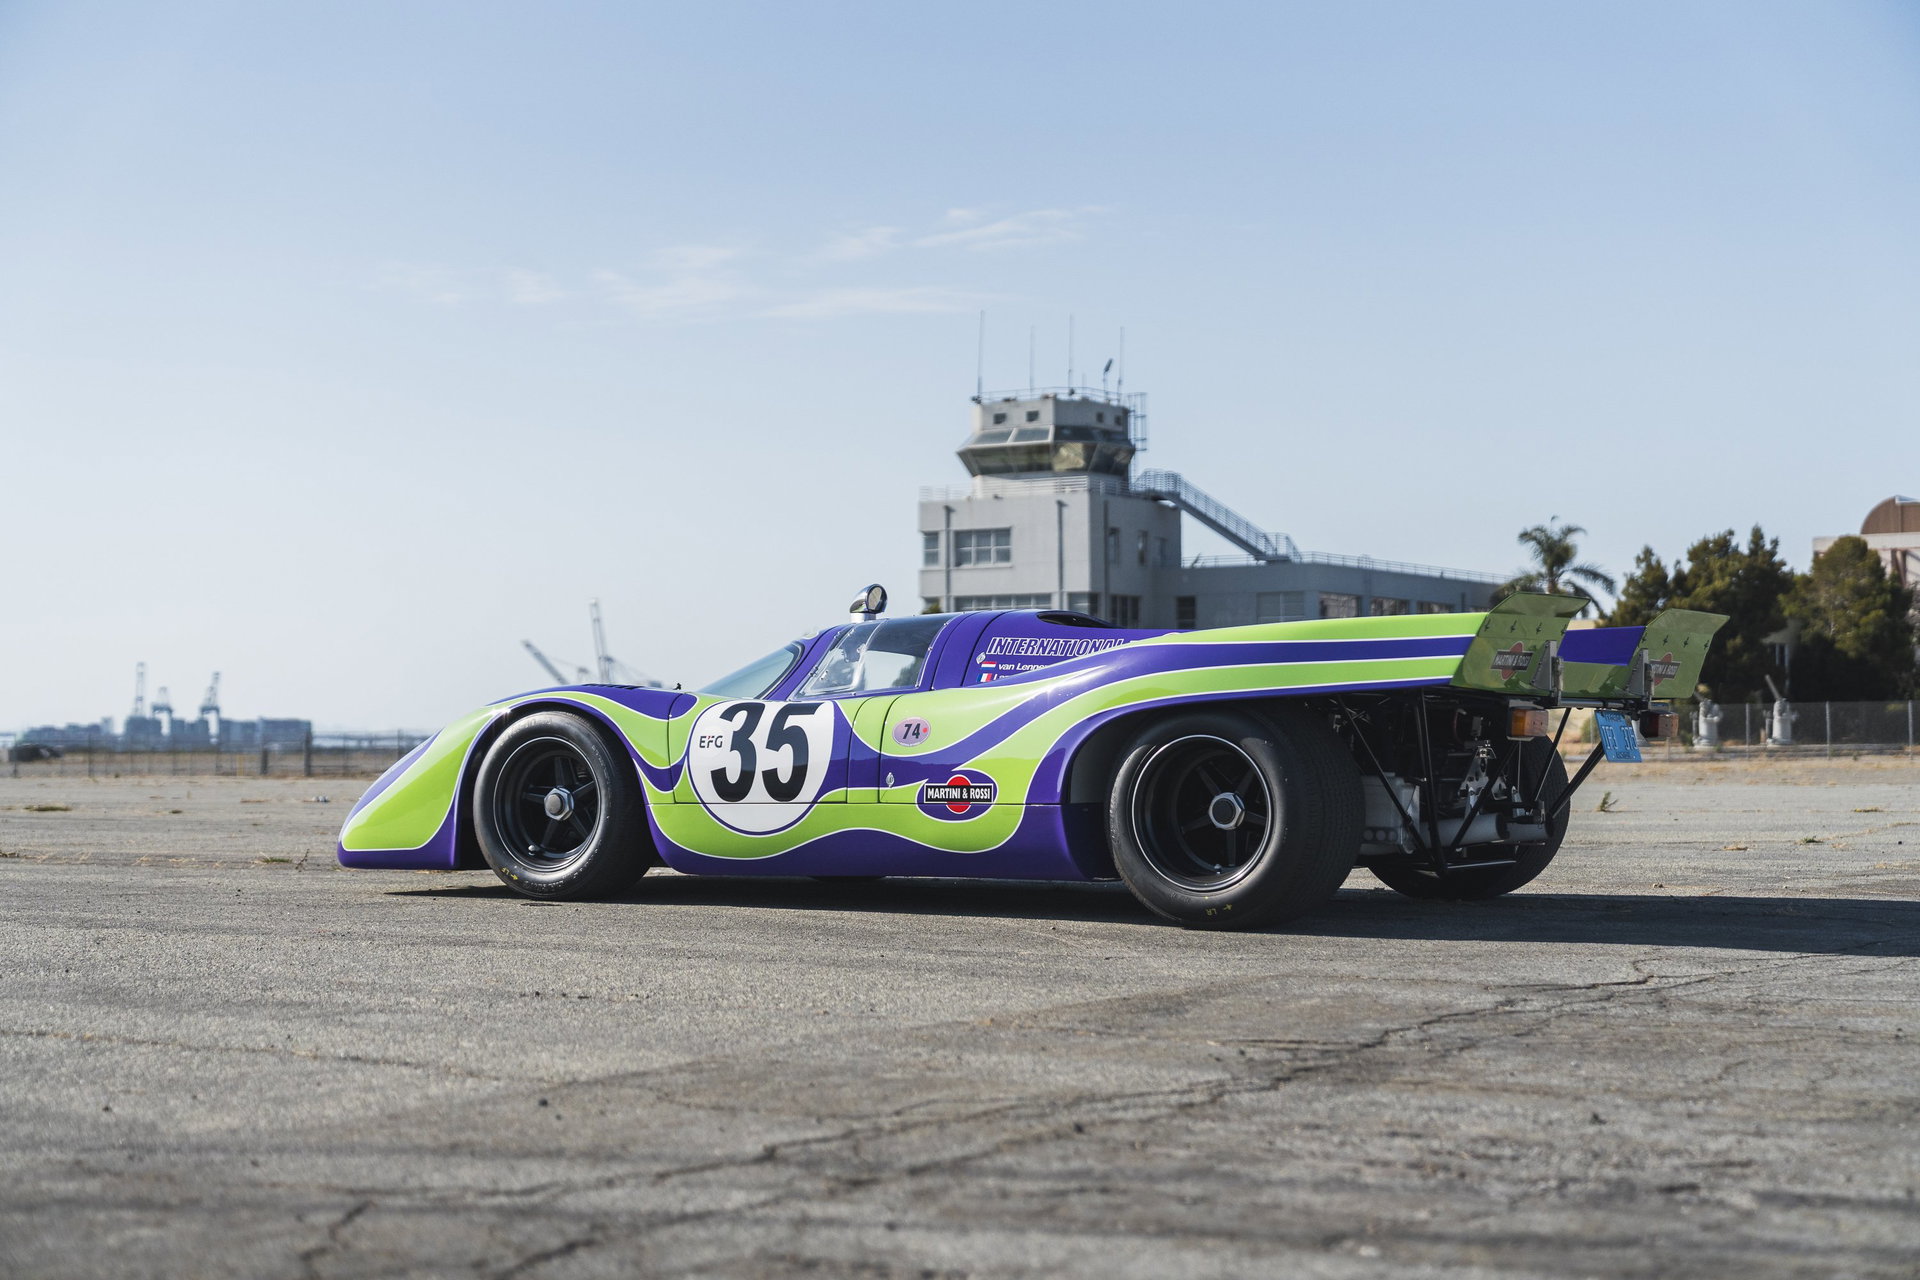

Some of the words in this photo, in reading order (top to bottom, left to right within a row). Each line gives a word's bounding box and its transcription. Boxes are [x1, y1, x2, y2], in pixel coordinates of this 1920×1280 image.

[902, 723, 920, 739] 74
[699, 735, 723, 748] EFG
[710, 702, 824, 802] 35
[927, 787, 960, 799] MARTINI
[962, 787, 968, 799] &
[969, 787, 990, 800] ROSSI
